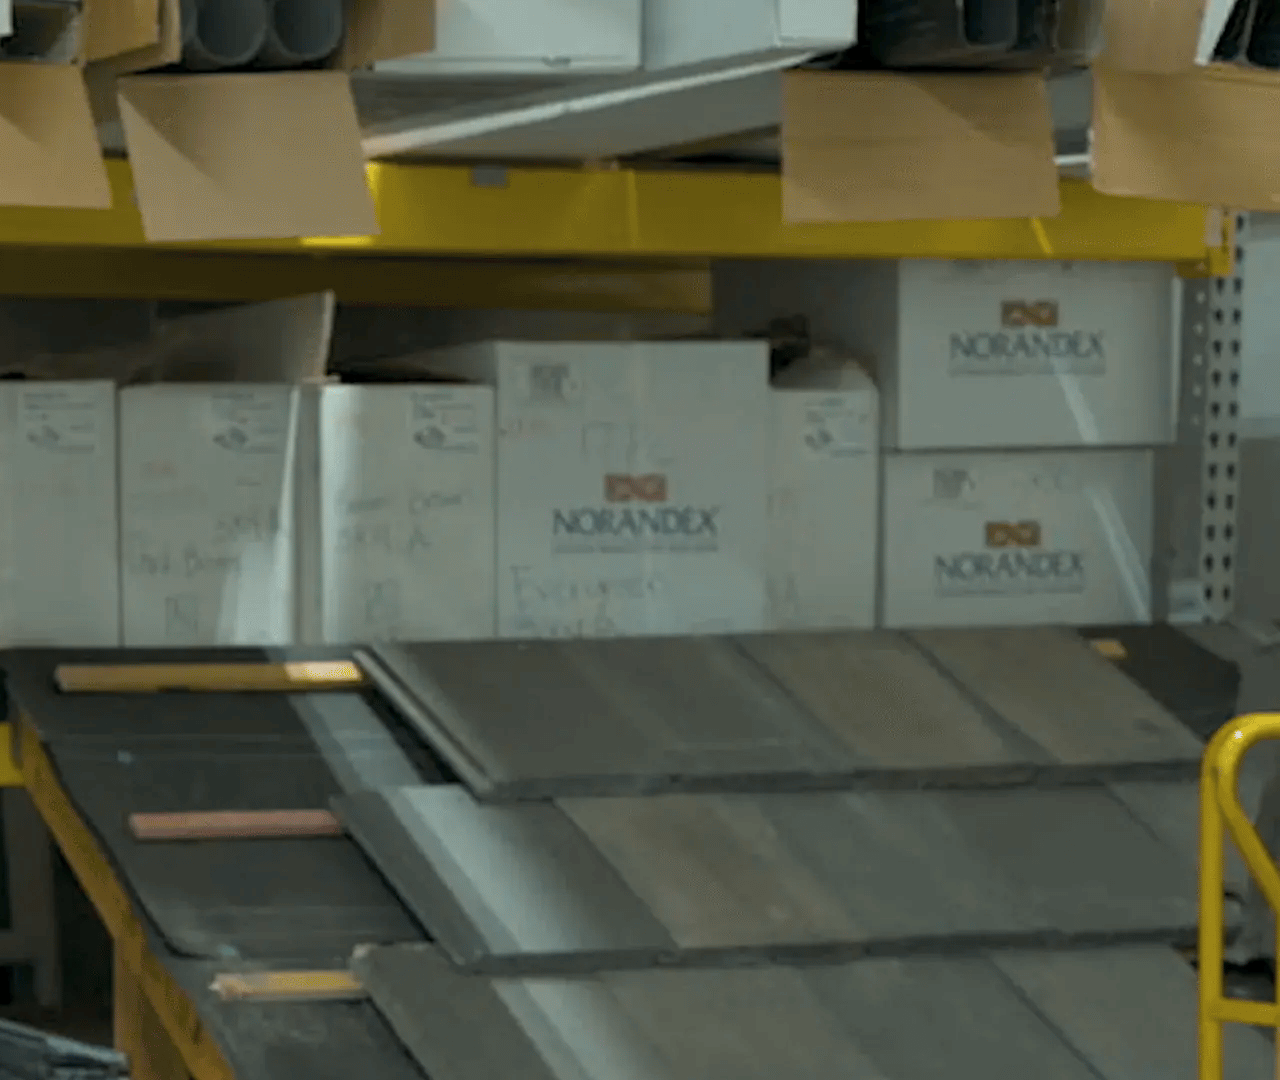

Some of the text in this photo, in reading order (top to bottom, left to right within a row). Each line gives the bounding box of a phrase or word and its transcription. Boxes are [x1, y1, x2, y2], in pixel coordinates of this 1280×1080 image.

[949, 331, 1106, 360] NORANDEX
[552, 507, 720, 537] NORANDEX
[934, 552, 1085, 580] NORANDEX
